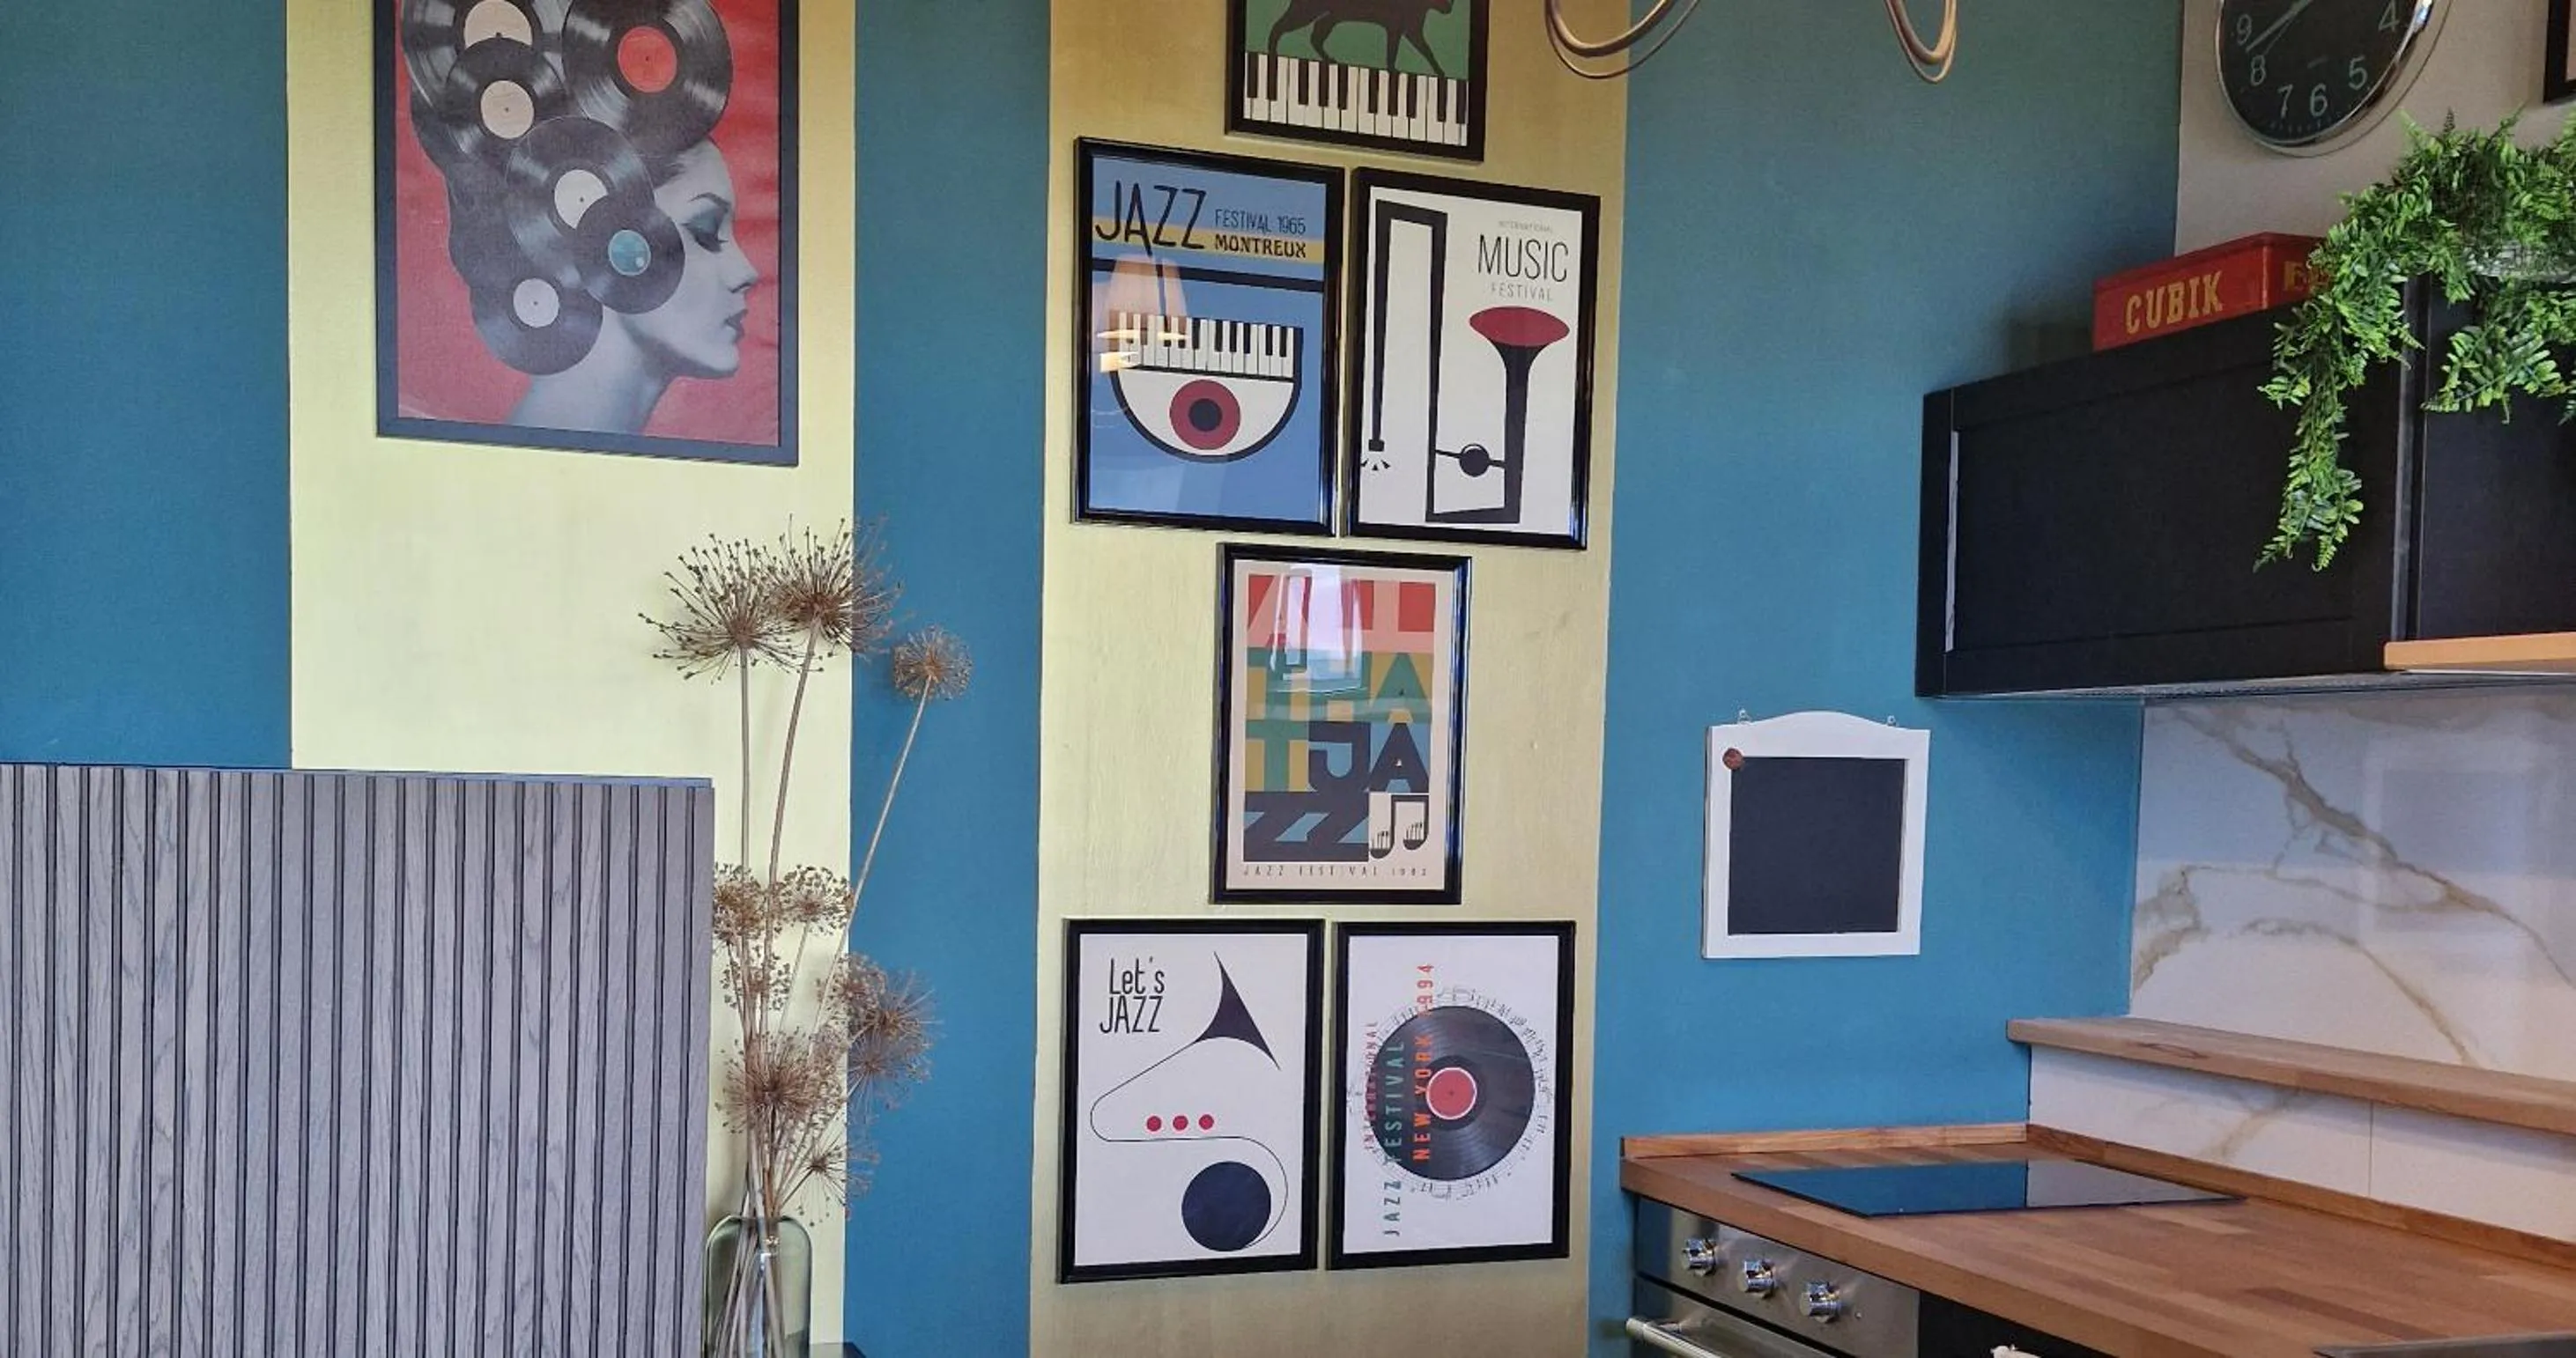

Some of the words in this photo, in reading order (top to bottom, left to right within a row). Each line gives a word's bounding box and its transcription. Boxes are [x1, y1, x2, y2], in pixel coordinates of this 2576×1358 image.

[2236, 14, 2253, 45] 9
[2379, 0, 2400, 32] 4
[2250, 54, 2267, 86] 8
[2348, 55, 2367, 89] 5
[2277, 84, 2293, 118] 7
[2309, 84, 2328, 116] 6
[1095, 180, 1207, 257] JAZZ
[1215, 209, 1271, 233] FESTIVAL
[1277, 217, 1306, 234] 1965
[1215, 233, 1306, 258] MONTREUX
[1478, 234, 1568, 282] MUSIC
[2125, 270, 2223, 335] CUBIK
[1109, 956, 1165, 994] Let's
[1099, 995, 1163, 1034] JAZZ
[1414, 1033, 1433, 1096] YORK
[1383, 1041, 1406, 1165] FESTIVAL
[1413, 1111, 1432, 1162] NEW
[1384, 1179, 1403, 1236] JAZZ
